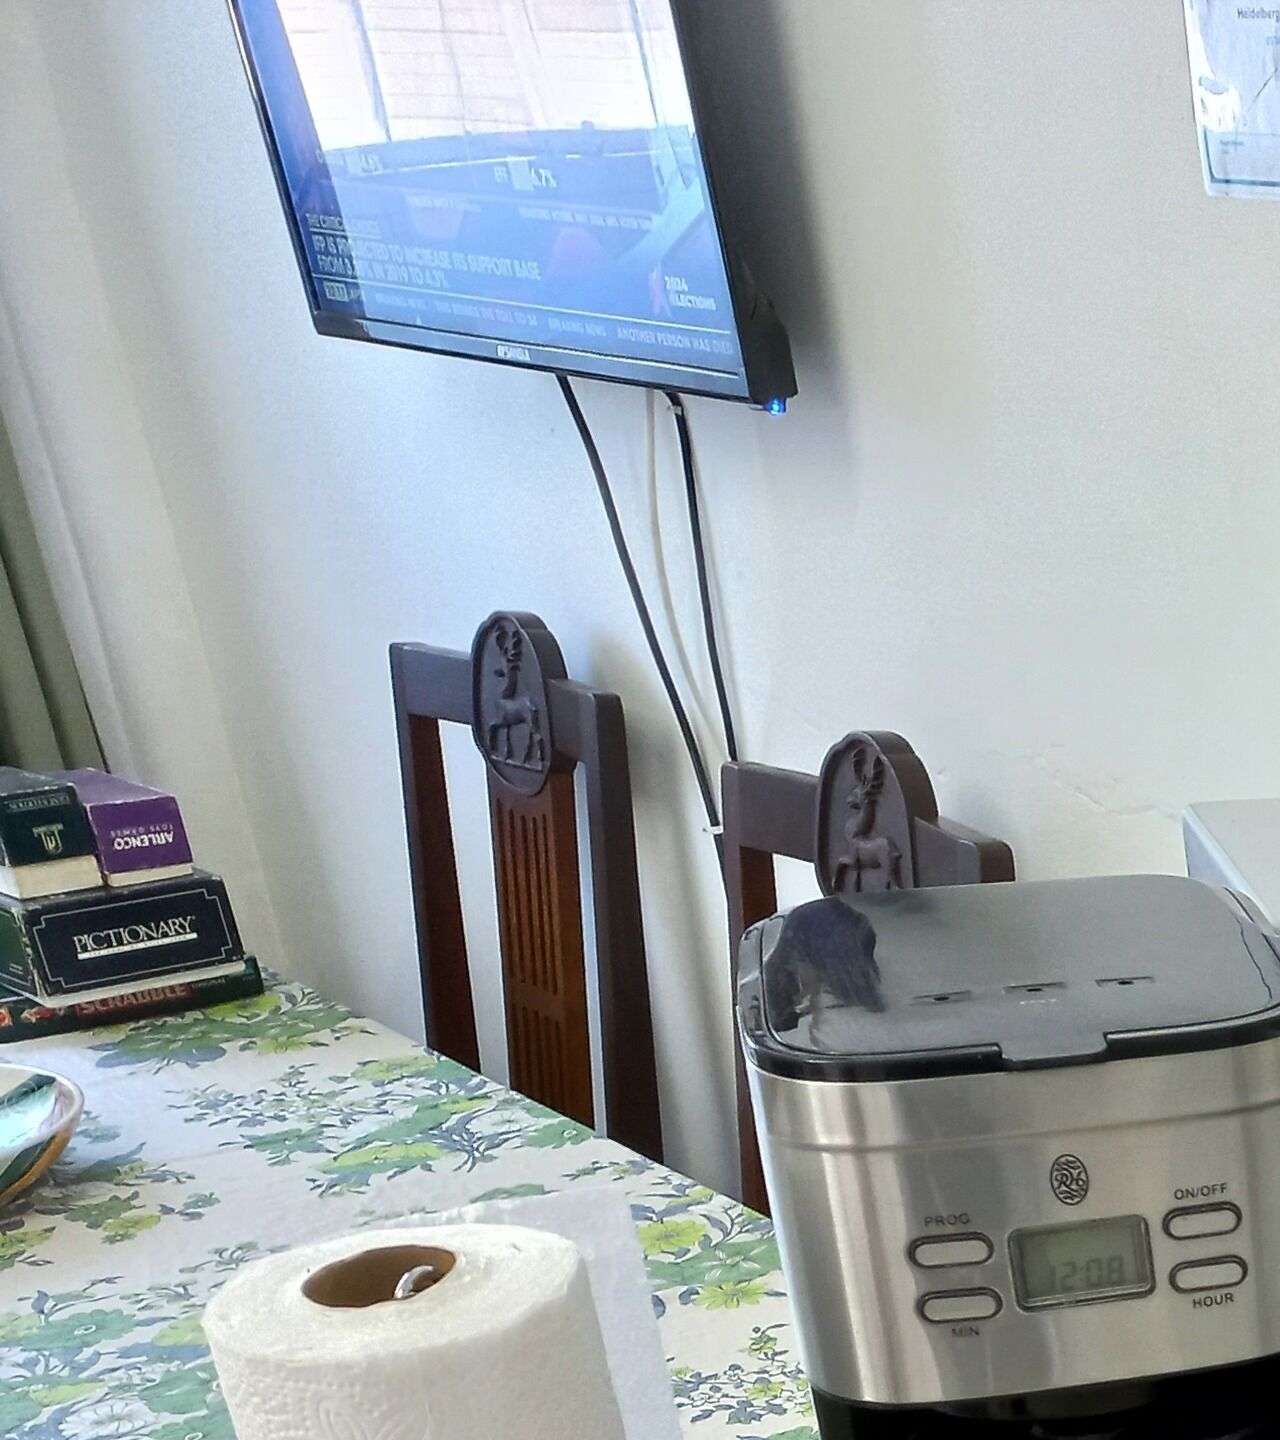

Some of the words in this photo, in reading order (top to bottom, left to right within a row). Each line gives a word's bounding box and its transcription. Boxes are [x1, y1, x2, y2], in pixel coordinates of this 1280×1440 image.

[1237, 8, 1280, 23] Heidelberg
[467, 254, 512, 276] SUPPORT
[513, 259, 541, 281] BASE
[617, 327, 656, 344] ANOTHER
[656, 331, 691, 348] PERSON
[691, 336, 712, 353] HAS
[113, 831, 175, 851] ARLENCO
[72, 915, 193, 954] PICTIONARY
[1173, 1182, 1228, 1201] ON/OFF
[923, 1212, 971, 1228] PROG
[1049, 1255, 1125, 1291] 12:08
[1192, 1292, 1235, 1310] HOUR
[951, 1325, 981, 1338] MIN
